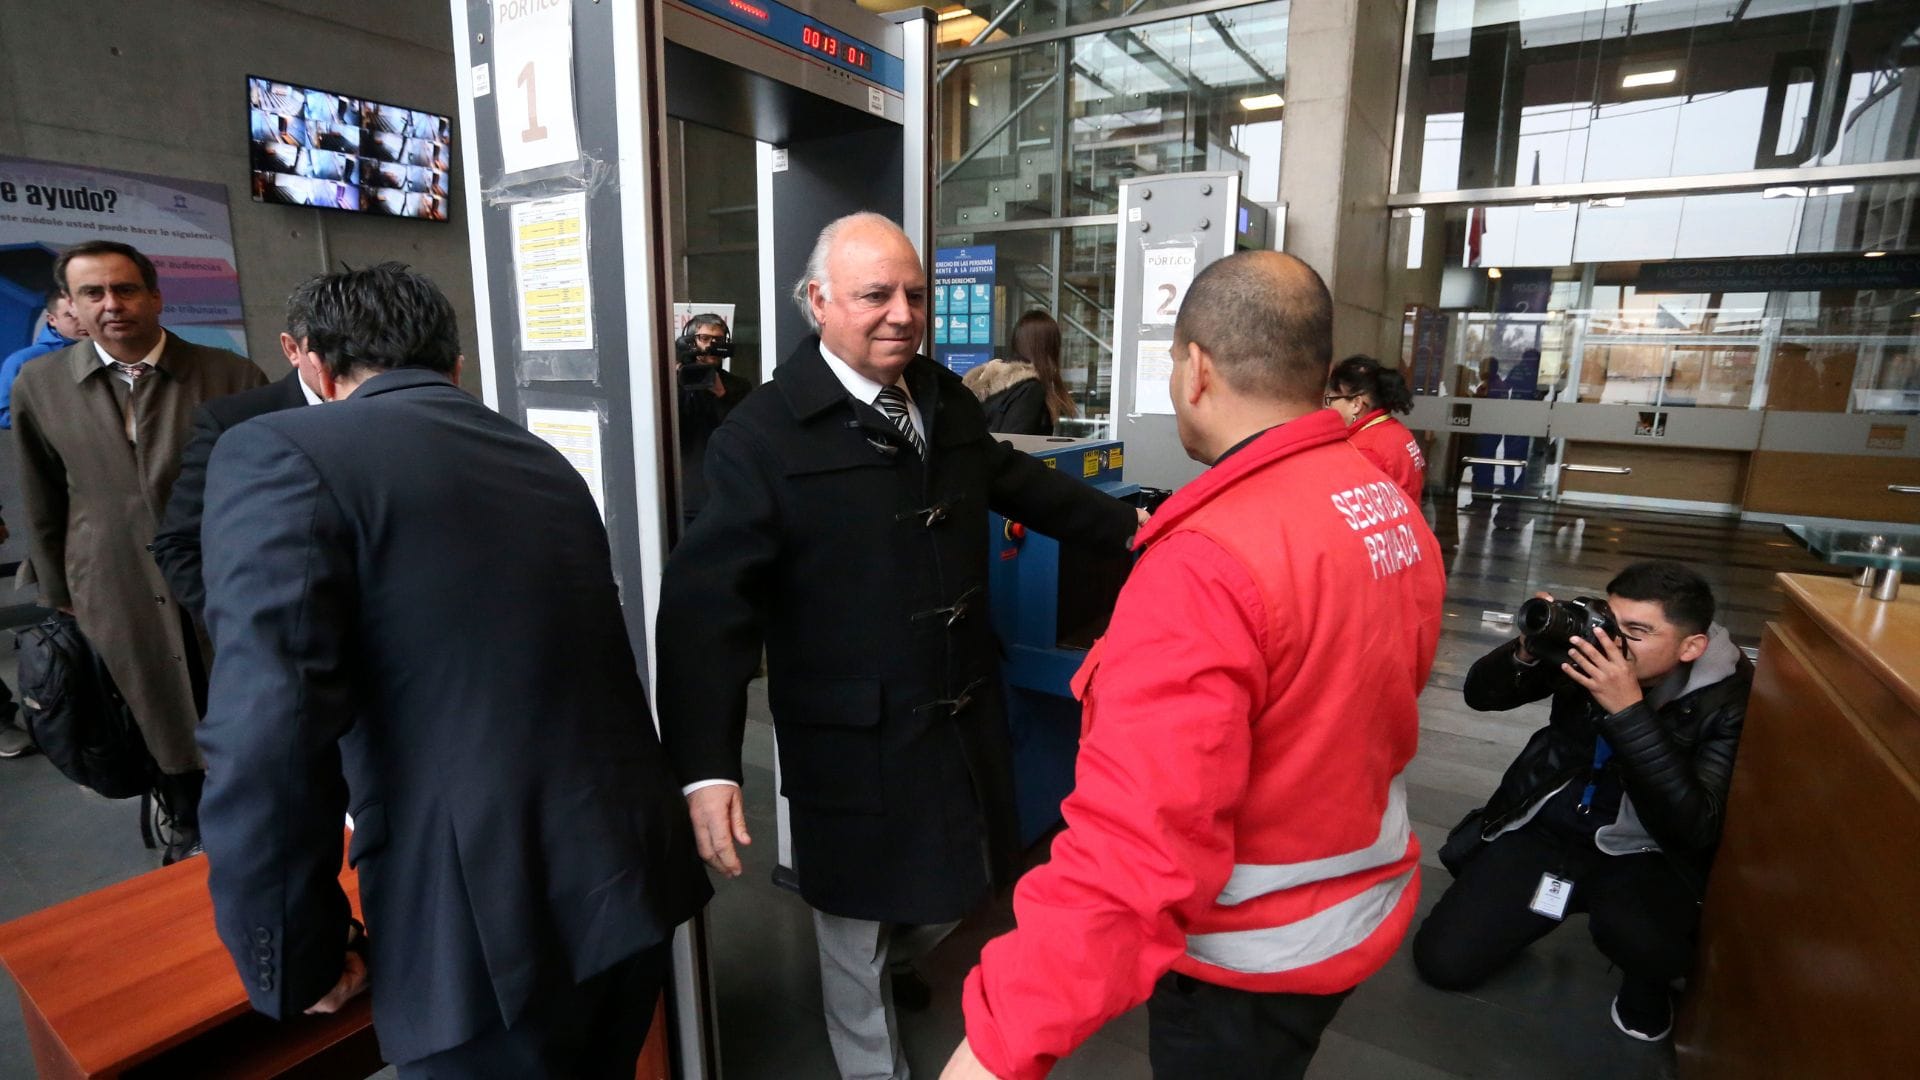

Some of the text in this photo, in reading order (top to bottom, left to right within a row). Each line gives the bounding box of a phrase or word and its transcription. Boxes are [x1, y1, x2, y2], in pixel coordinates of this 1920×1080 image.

[802, 26, 838, 56] 0013
[517, 61, 548, 143] 1
[0, 181, 118, 213] e ayudo?
[66, 220, 95, 230] usted
[98, 223, 128, 232] puede
[130, 225, 157, 235] hacer
[969, 265, 993, 273] JUSTICIA
[1828, 262, 1849, 274] DE
[1855, 260, 1920, 273] PUBLIC
[1157, 283, 1177, 316] 2
